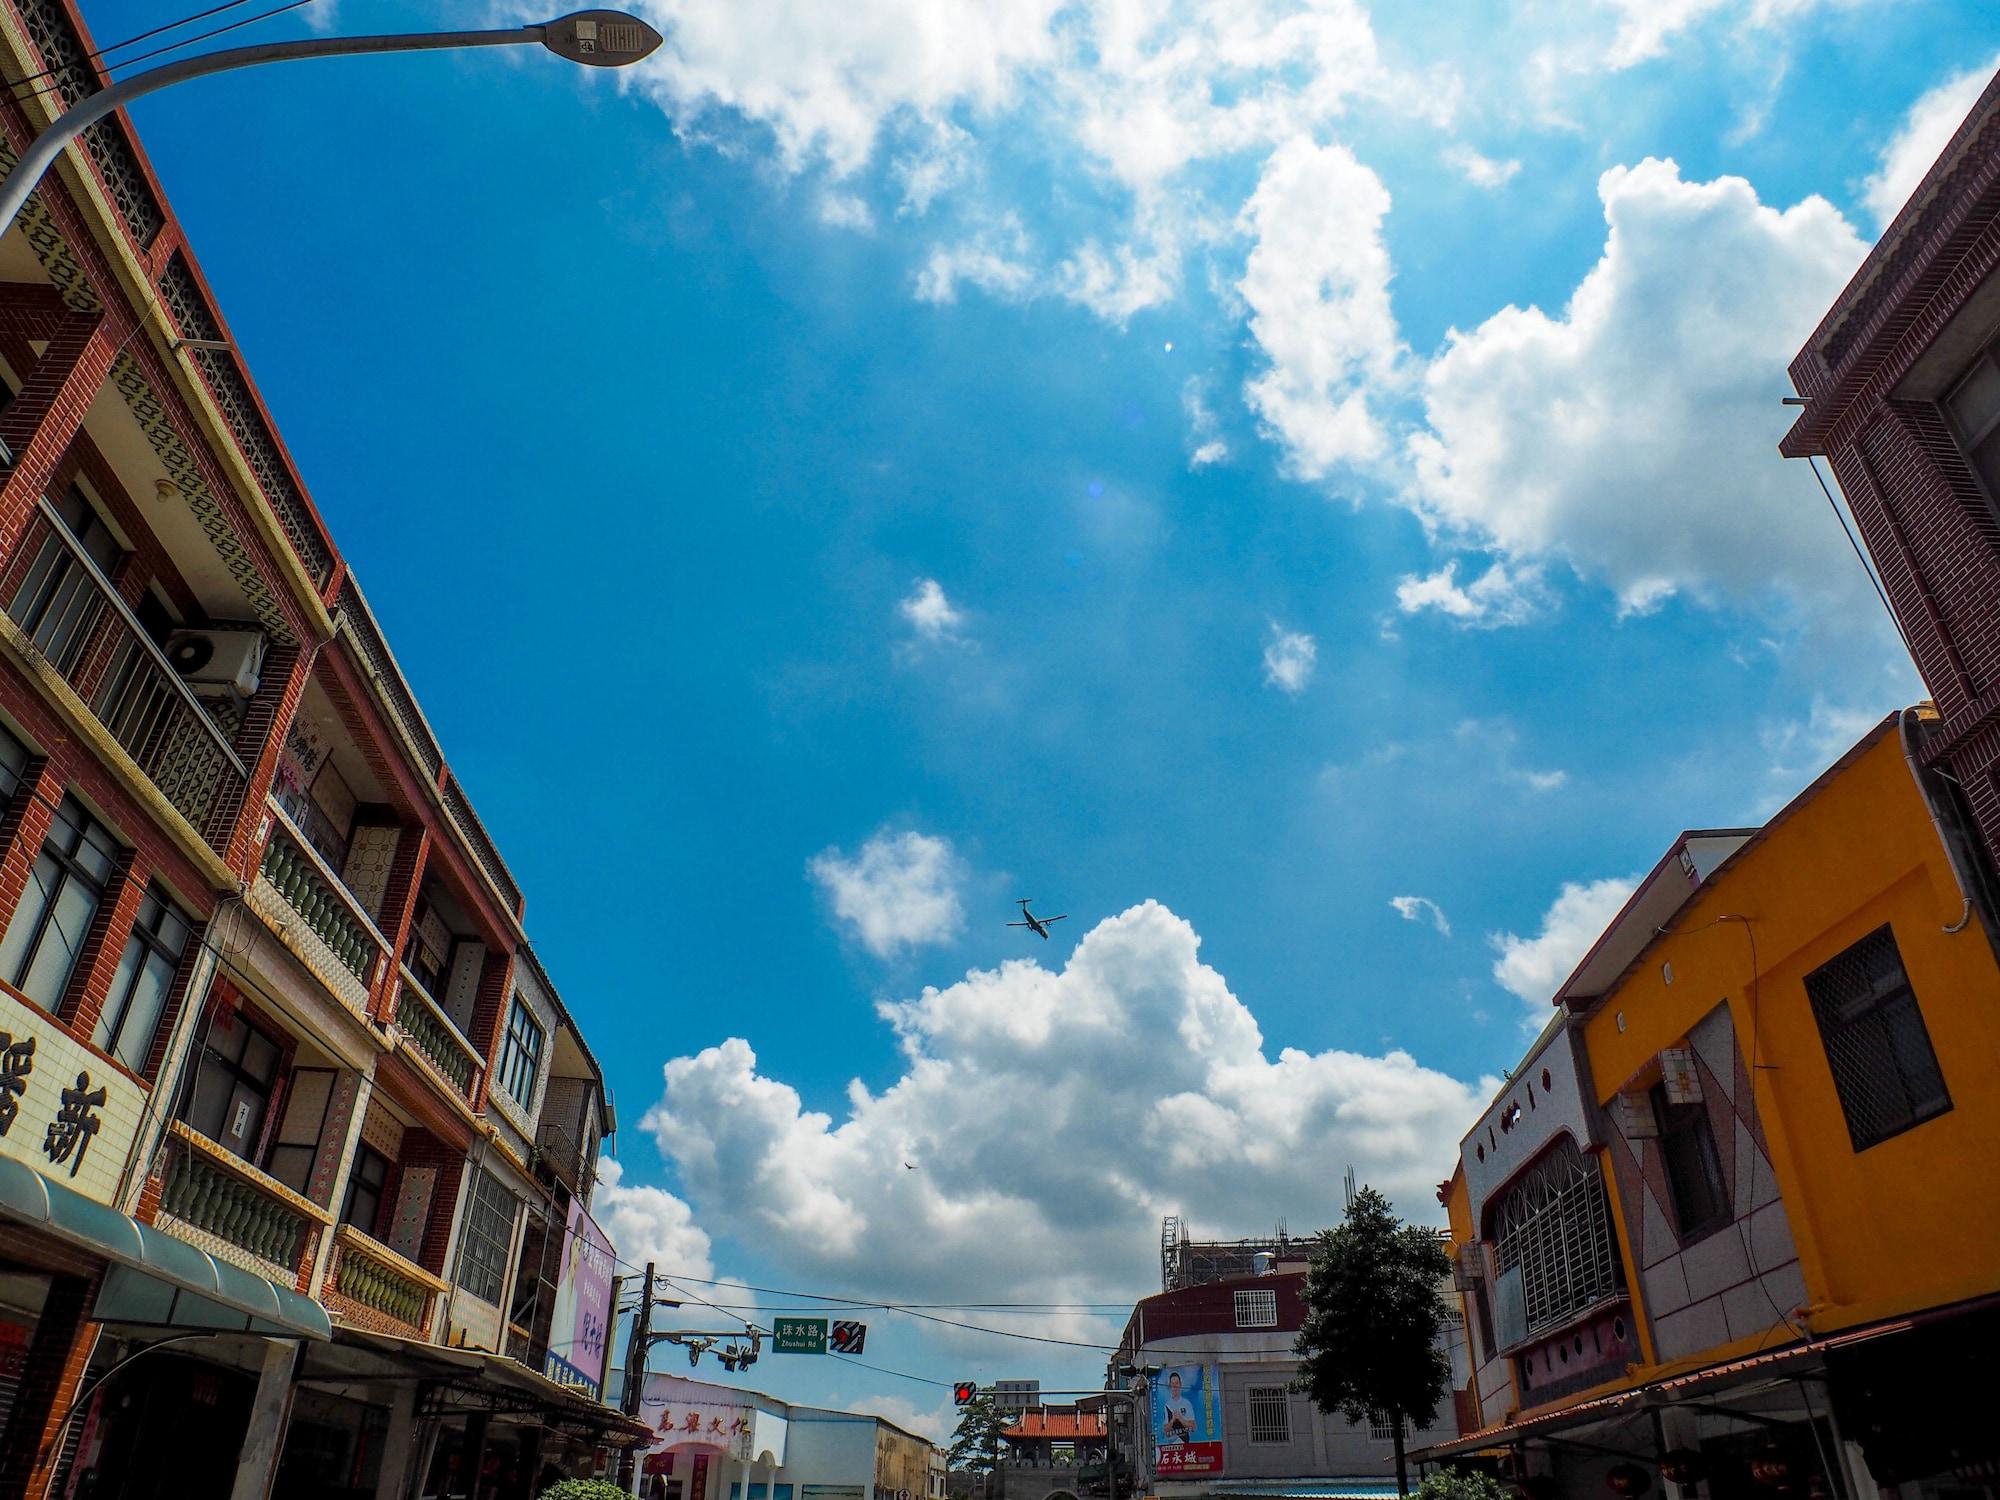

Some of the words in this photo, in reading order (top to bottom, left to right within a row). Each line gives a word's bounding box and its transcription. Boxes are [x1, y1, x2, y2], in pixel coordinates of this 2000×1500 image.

[782, 1324, 818, 1337] 珠水路
[781, 1340, 806, 1348] Zhushui
[1161, 1451, 1197, 1465] 石永城
